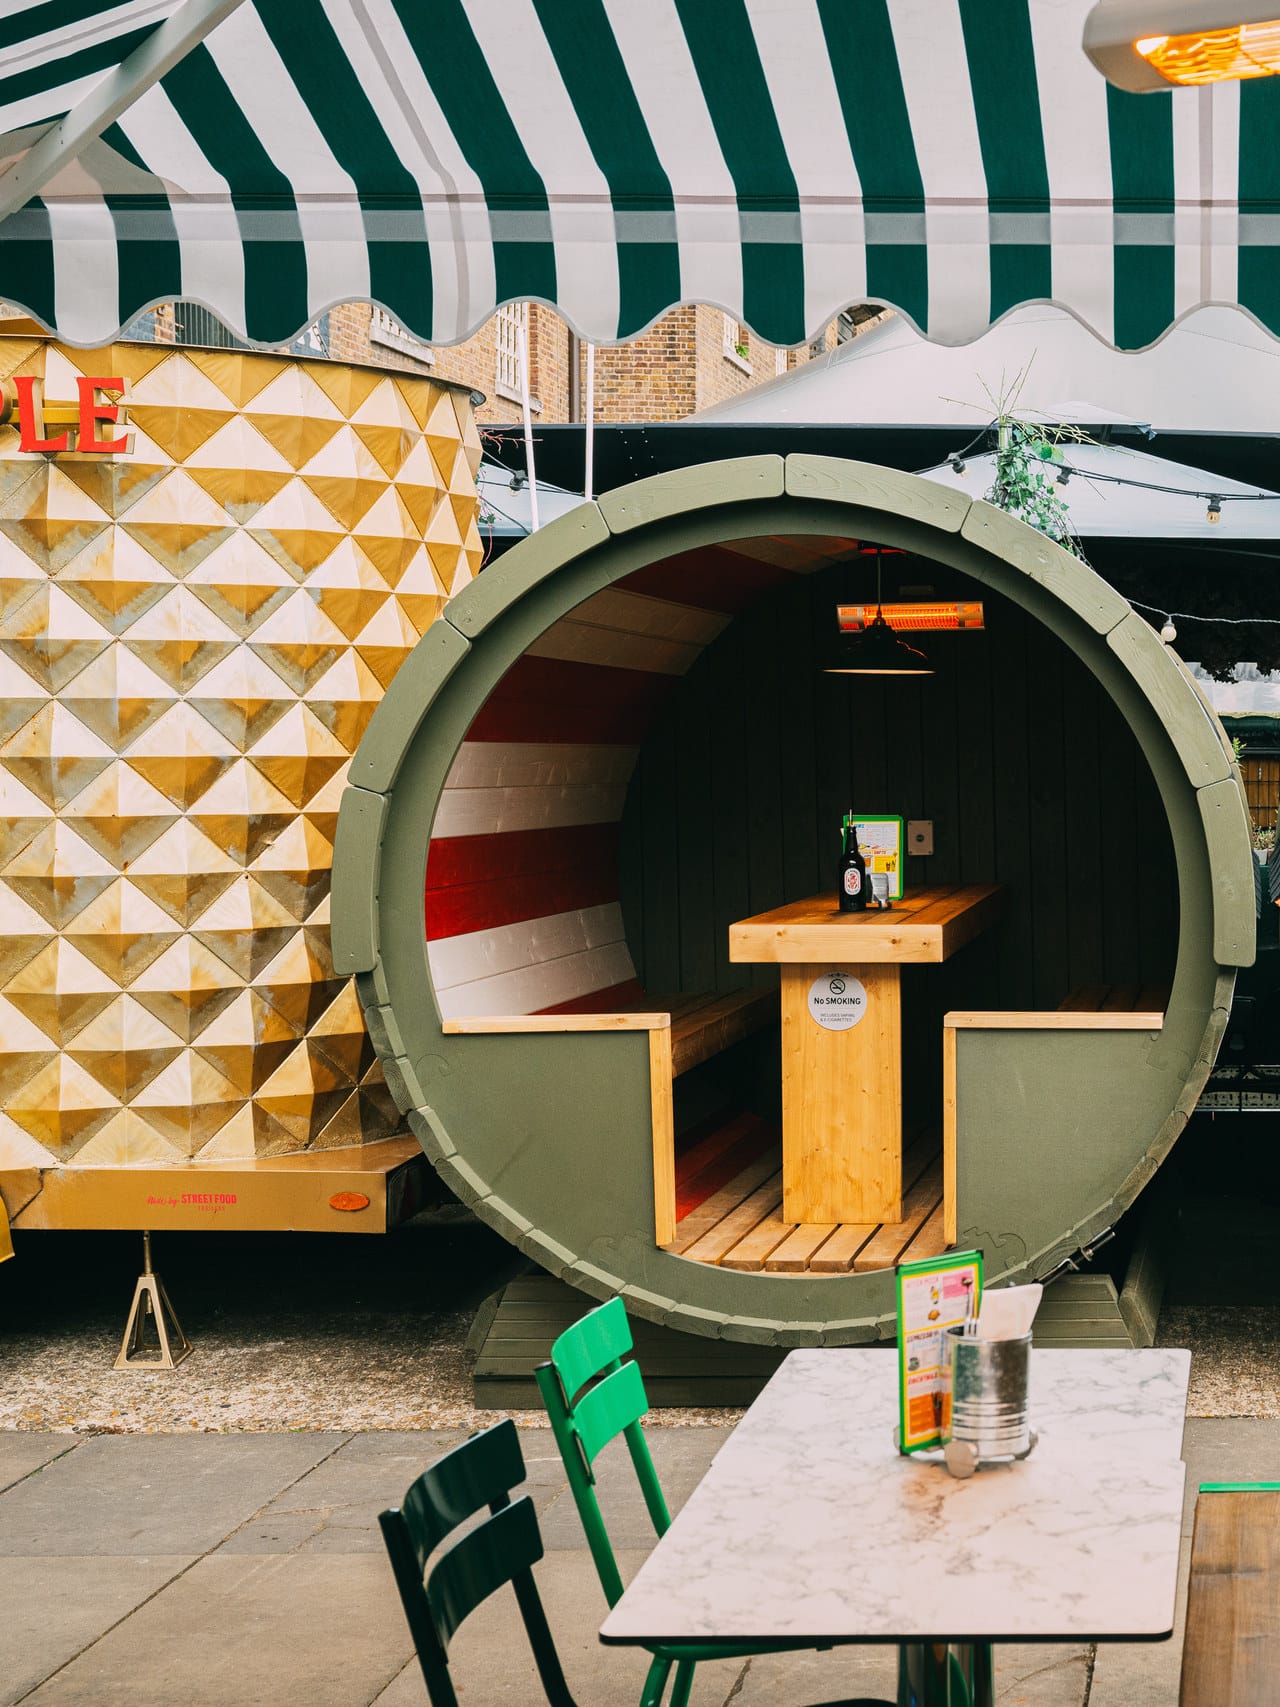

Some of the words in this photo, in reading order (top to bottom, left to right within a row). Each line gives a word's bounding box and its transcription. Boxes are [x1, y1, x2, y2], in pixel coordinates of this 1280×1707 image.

[0, 376, 129, 453] LE
[814, 997, 825, 1005] No
[826, 997, 861, 1005] SMOKING
